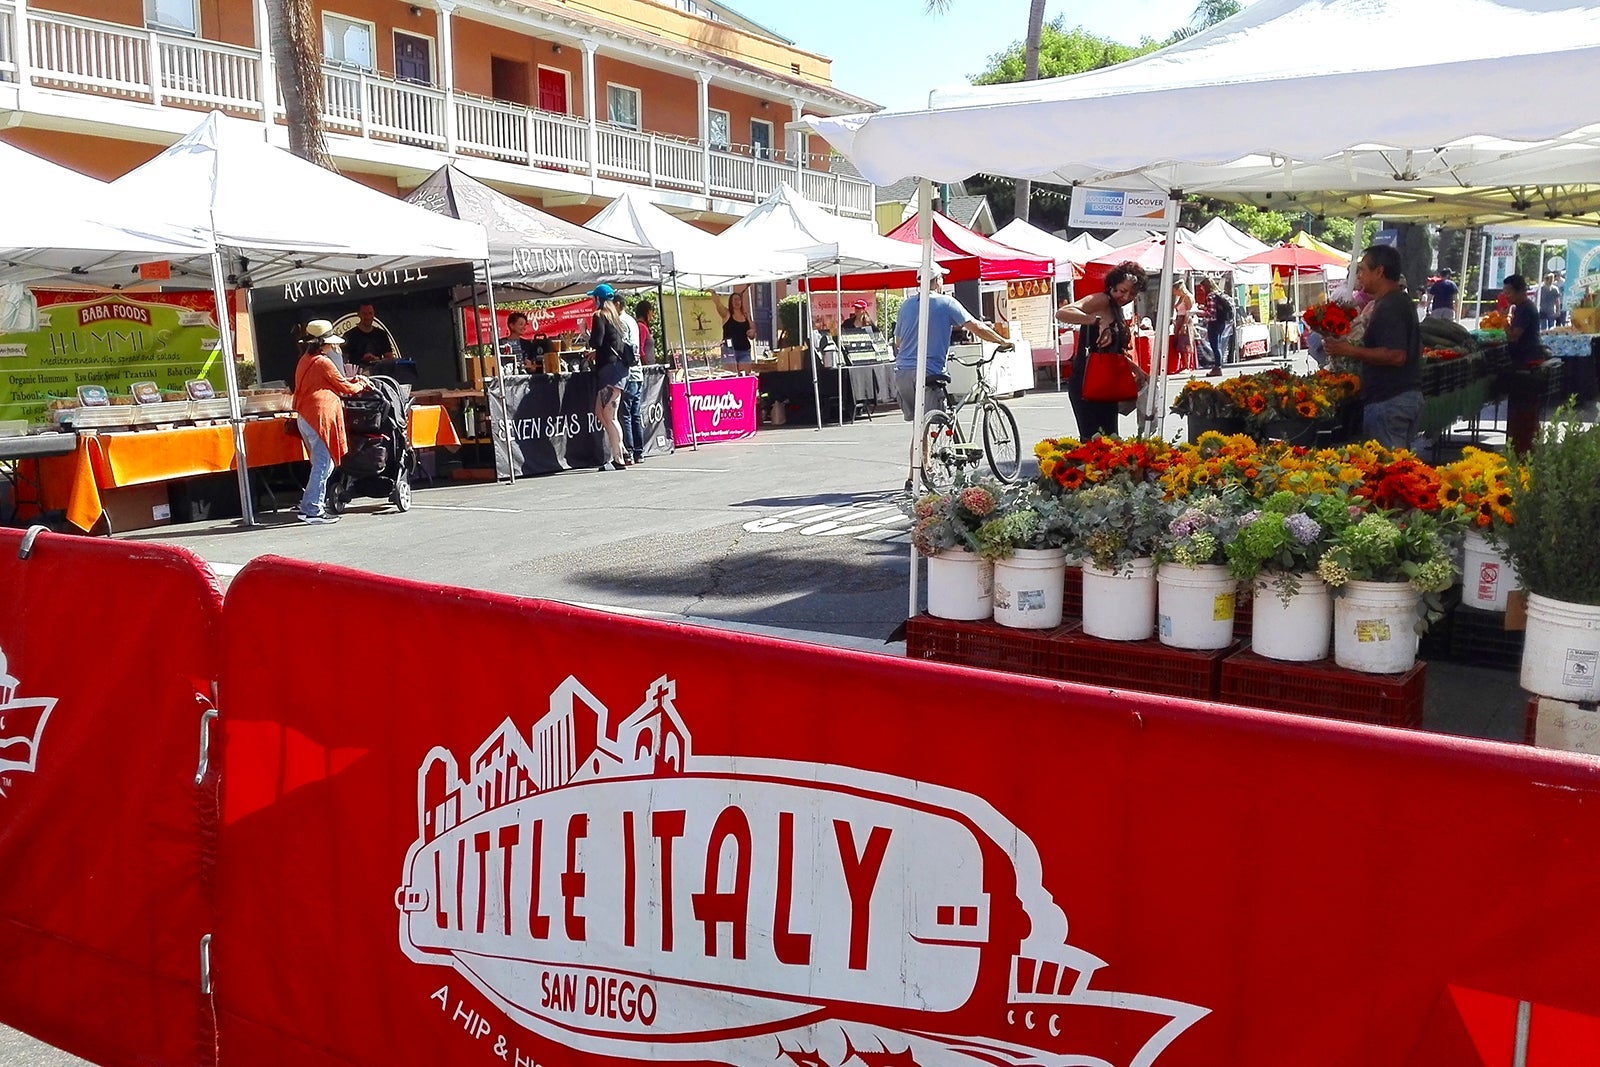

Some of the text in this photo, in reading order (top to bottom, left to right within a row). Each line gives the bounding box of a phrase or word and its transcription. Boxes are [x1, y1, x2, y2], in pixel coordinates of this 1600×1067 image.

[1128, 198, 1164, 207] DISCOVER
[512, 247, 634, 277] ARTISAN COFFEE
[82, 303, 148, 323] BABA FOODS
[49, 329, 171, 355] HUMMUS
[40, 356, 98, 366] Mediterranean
[156, 353, 181, 362] salads
[8, 373, 69, 387] Organic Hummus
[123, 370, 158, 379] Tzatziki
[167, 366, 184, 377] Baba
[498, 417, 542, 442] SEVEN
[545, 413, 581, 439] SEAS
[2, 776, 12, 788] TM
[434, 805, 893, 971] LITTLE ITALY
[540, 971, 657, 1027] SAN DIEGO
[430, 985, 449, 1012] A
[452, 1000, 492, 1040] HIP
[493, 1034, 509, 1061] &
